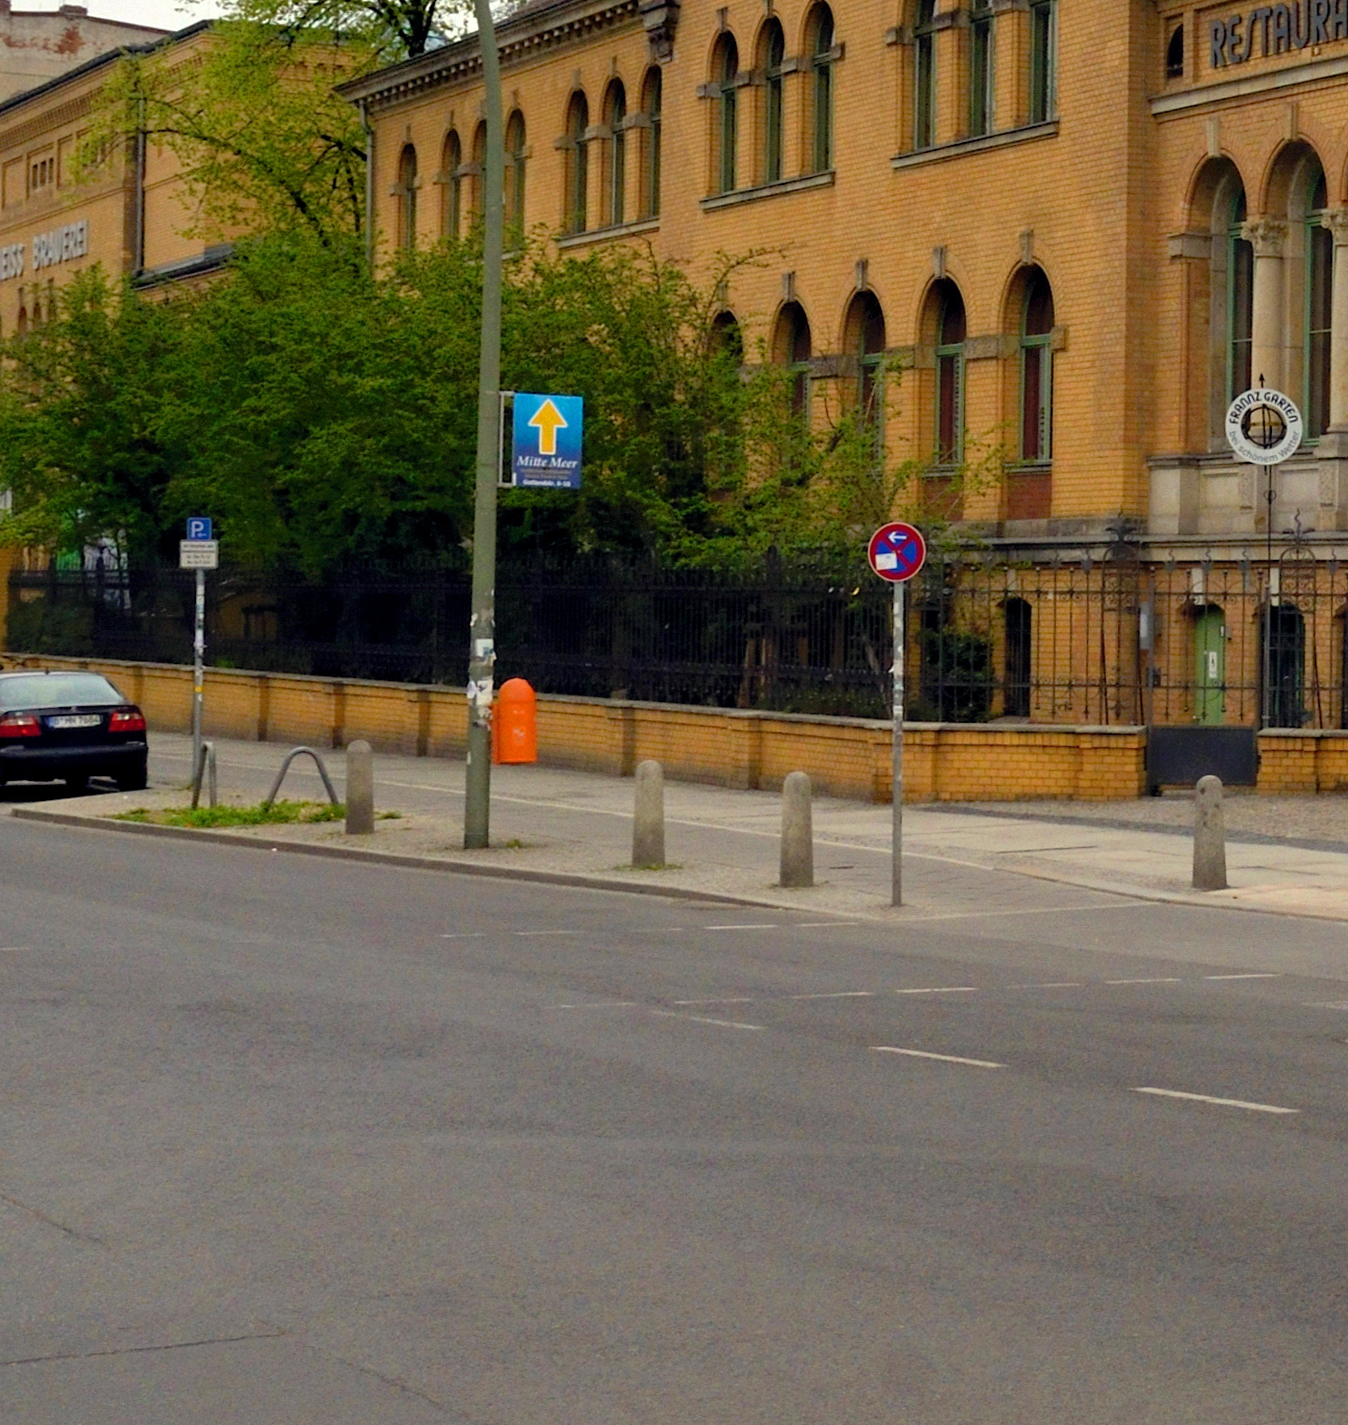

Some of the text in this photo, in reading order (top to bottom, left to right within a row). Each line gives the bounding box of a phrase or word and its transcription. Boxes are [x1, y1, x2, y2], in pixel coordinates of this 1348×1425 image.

[1229, 391, 1299, 425] FRANNZ GARTEN
[516, 455, 578, 468] Mitte Meer
[191, 521, 204, 538] P
